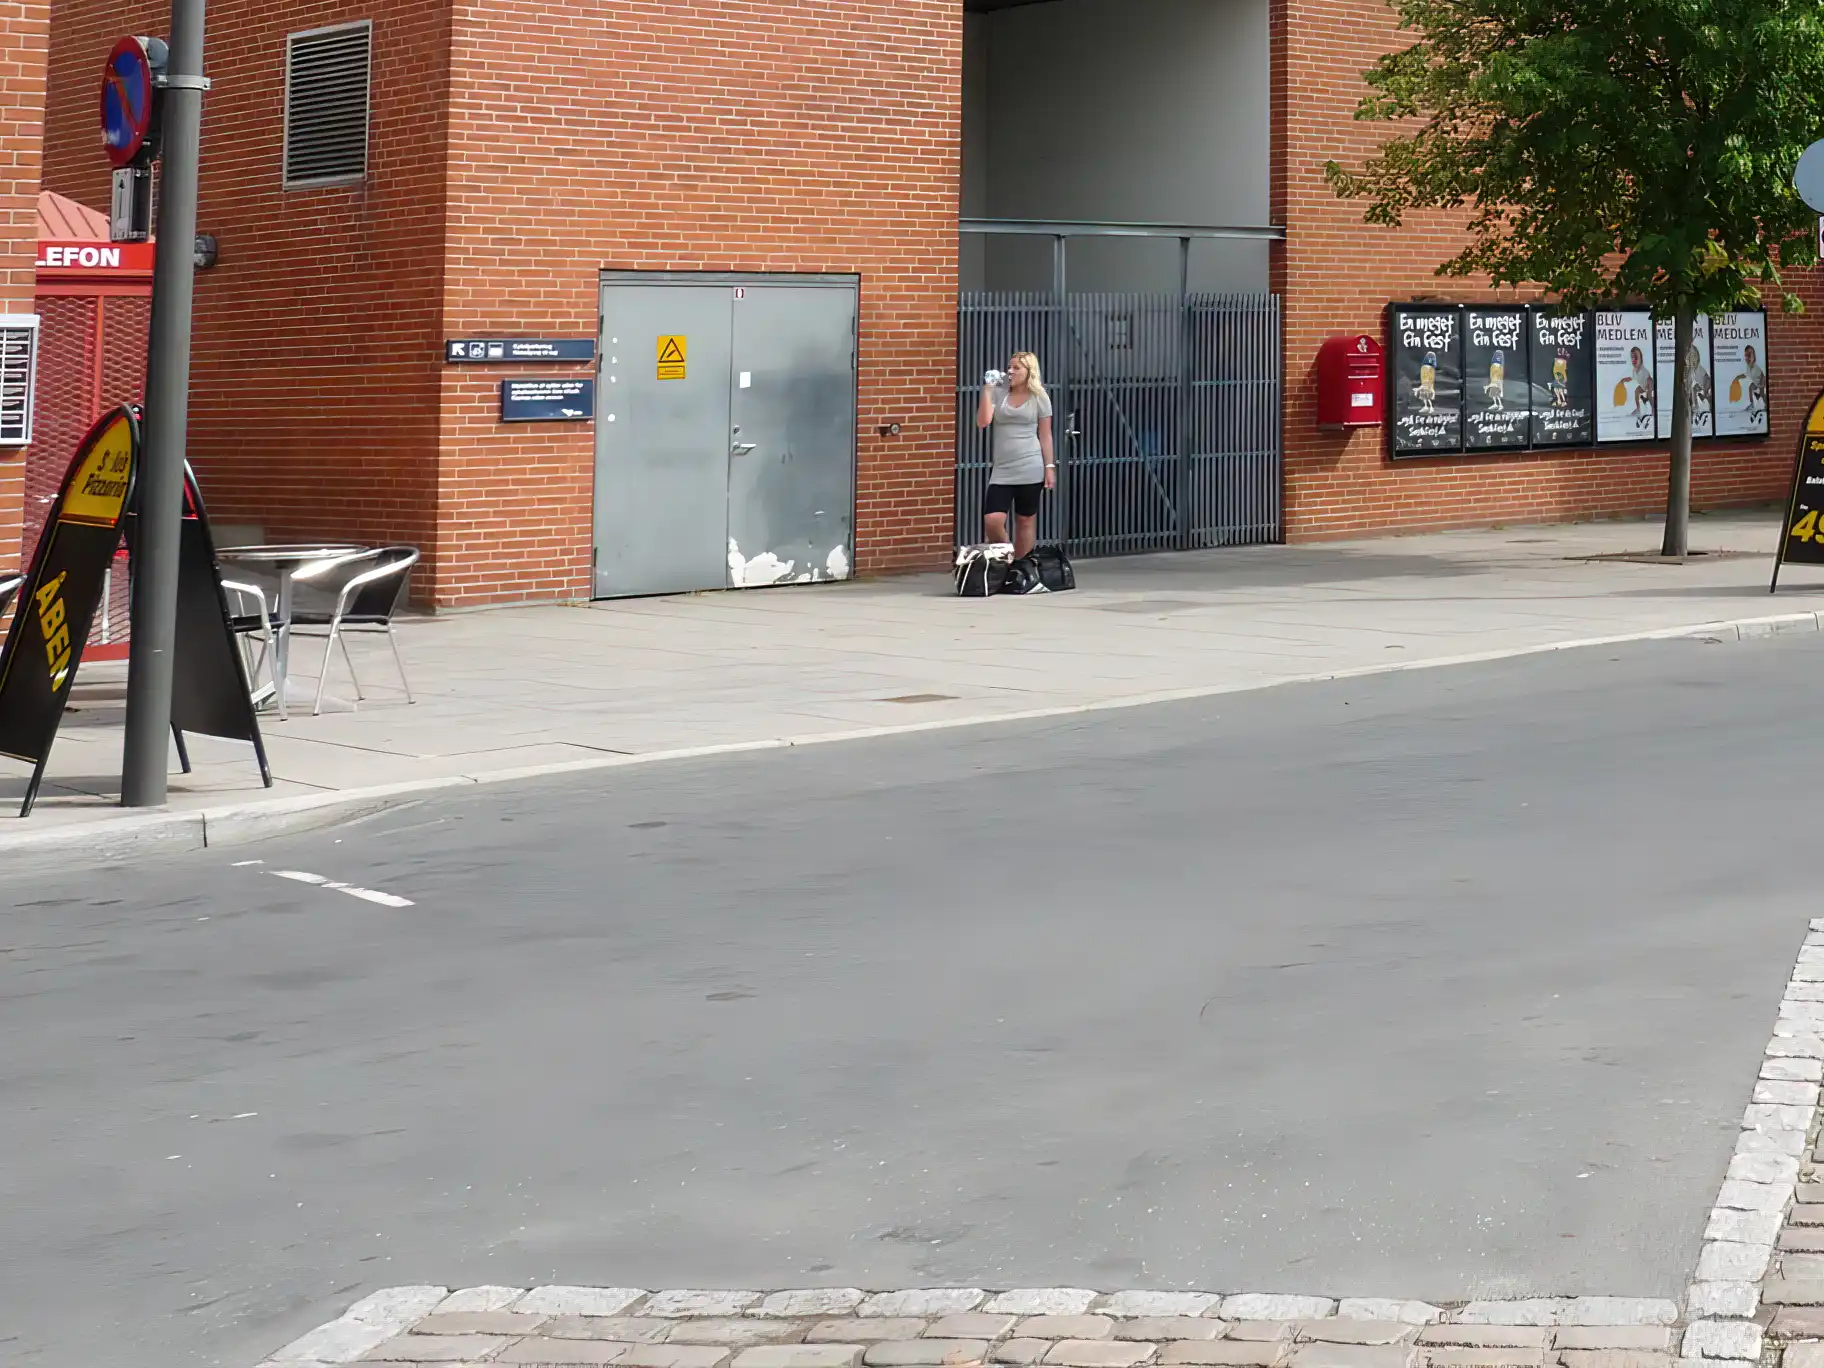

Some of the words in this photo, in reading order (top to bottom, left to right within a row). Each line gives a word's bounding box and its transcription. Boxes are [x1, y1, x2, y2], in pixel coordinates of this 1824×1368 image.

[1416, 314, 1454, 334] meget
[1485, 313, 1522, 333] meget
[1597, 314, 1622, 326] BLIV
[1597, 328, 1648, 341] MEDLEM
[1714, 328, 1760, 340] MEDLEM
